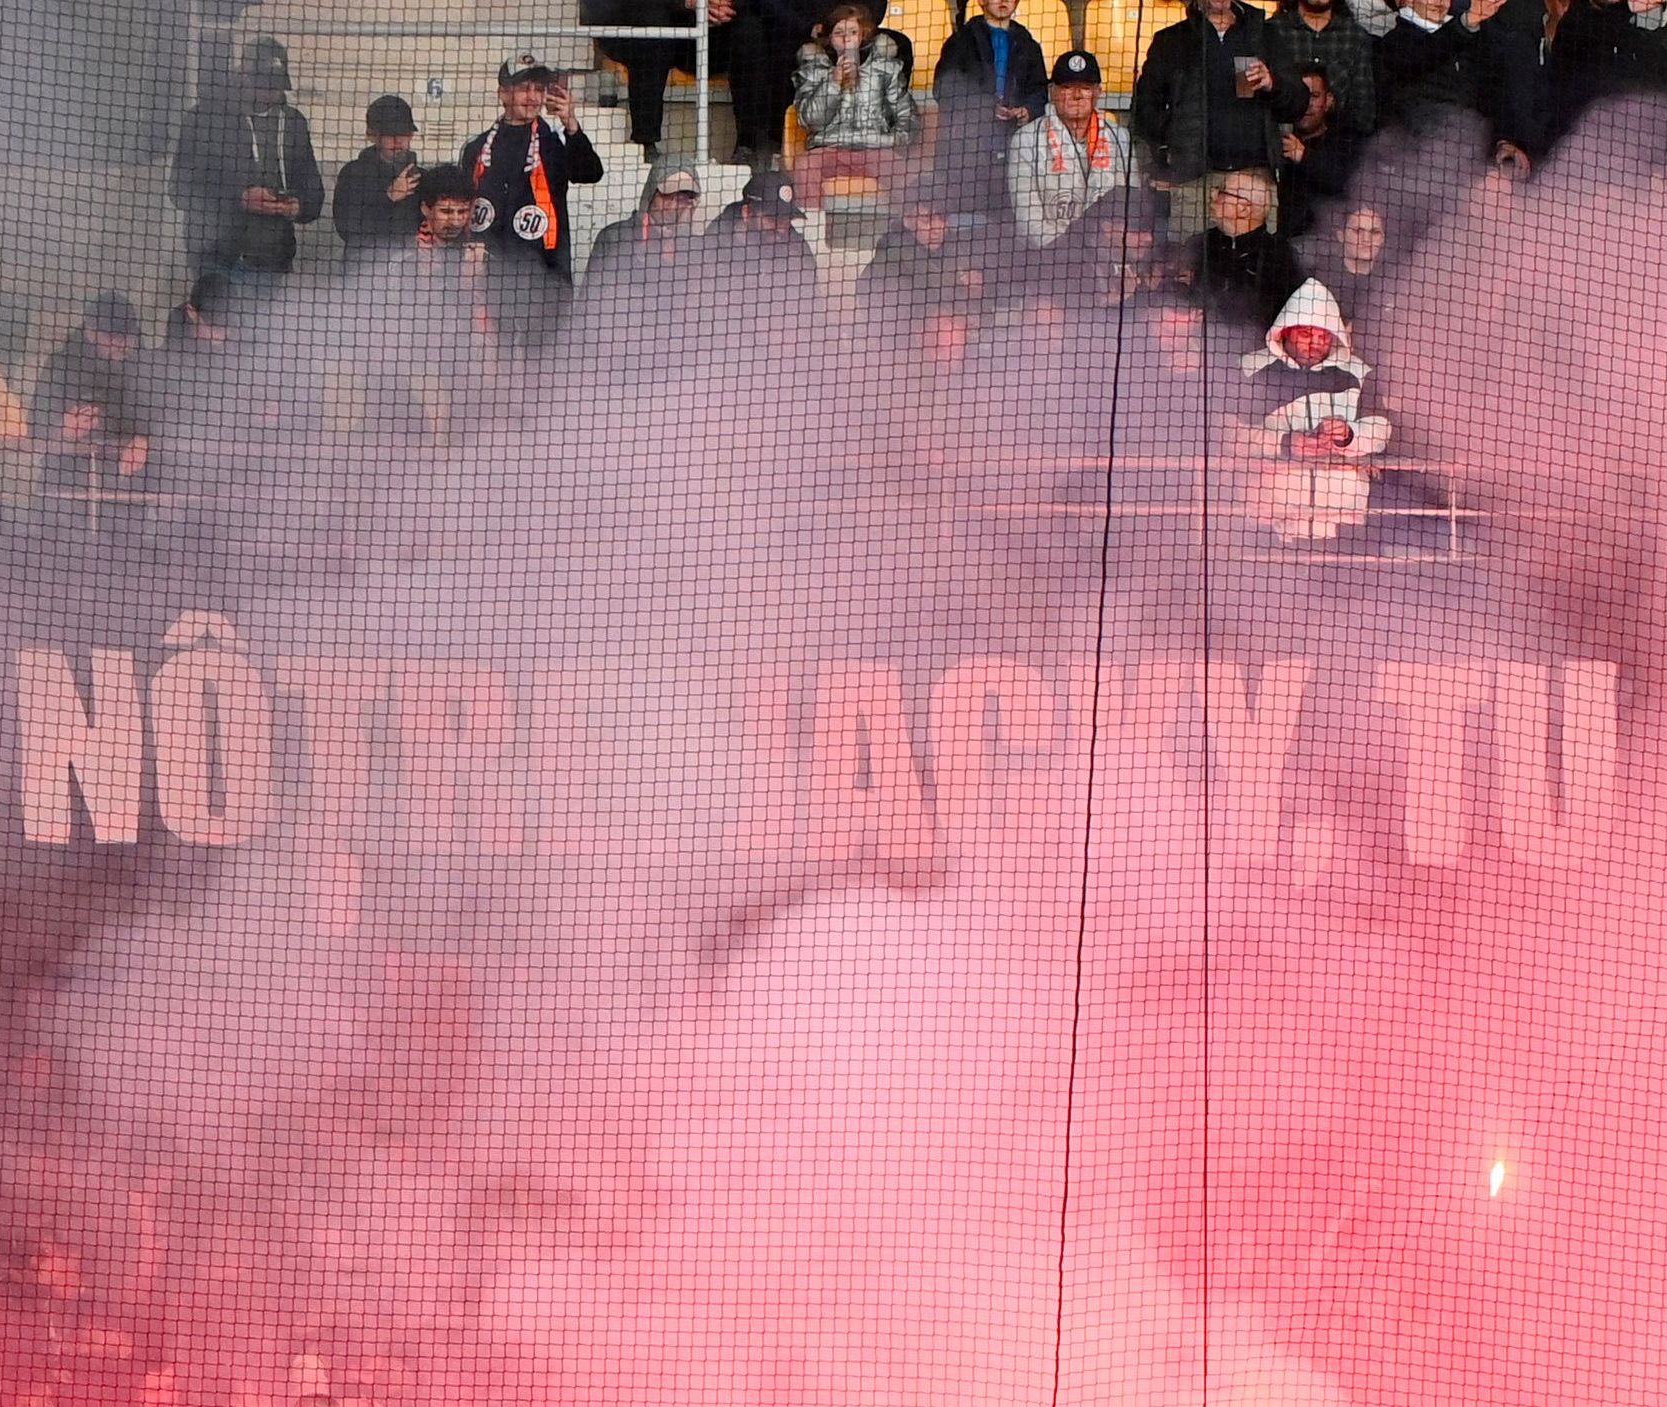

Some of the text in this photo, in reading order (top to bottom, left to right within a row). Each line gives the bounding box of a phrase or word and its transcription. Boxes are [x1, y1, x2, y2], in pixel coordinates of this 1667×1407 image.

[520, 216, 542, 233] 50
[15, 609, 532, 858] NÔTR
[1376, 659, 1620, 872] TU
